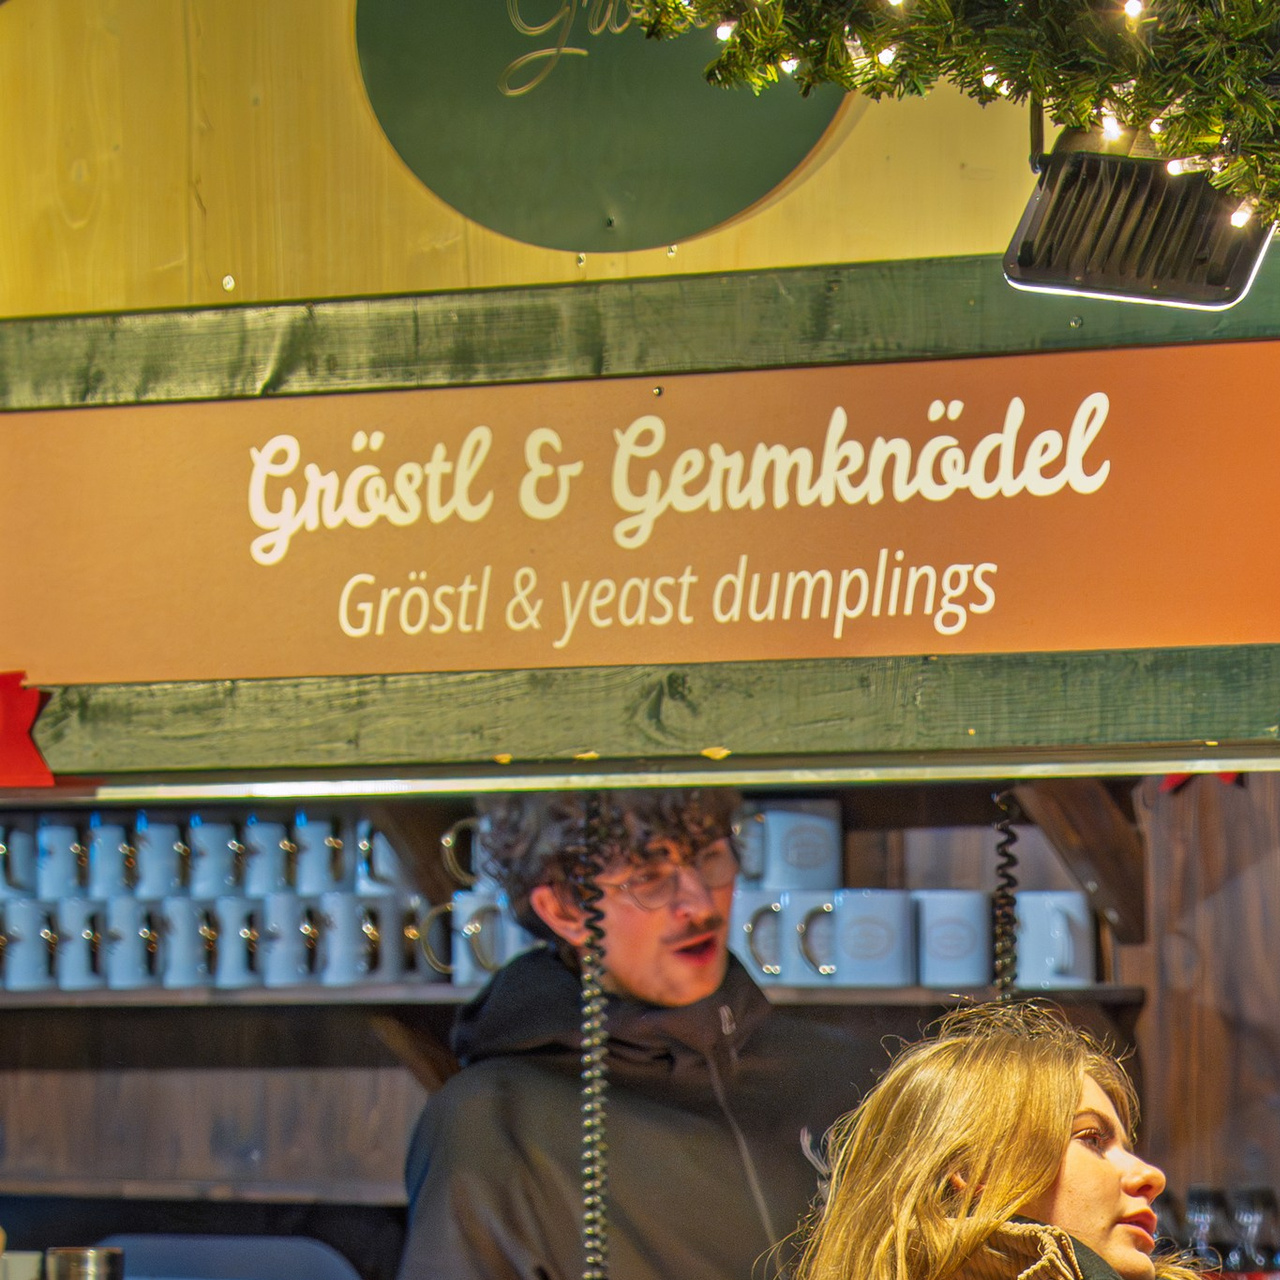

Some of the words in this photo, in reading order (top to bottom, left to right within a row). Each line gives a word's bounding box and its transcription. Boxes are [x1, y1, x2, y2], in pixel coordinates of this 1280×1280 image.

[248, 425, 494, 565] Gröstl
[519, 427, 584, 521] &
[611, 391, 1111, 550] Germknödel
[338, 564, 492, 638] Gröstl
[505, 566, 544, 632] &
[552, 564, 699, 649] yeast
[712, 548, 998, 640] dumplings
